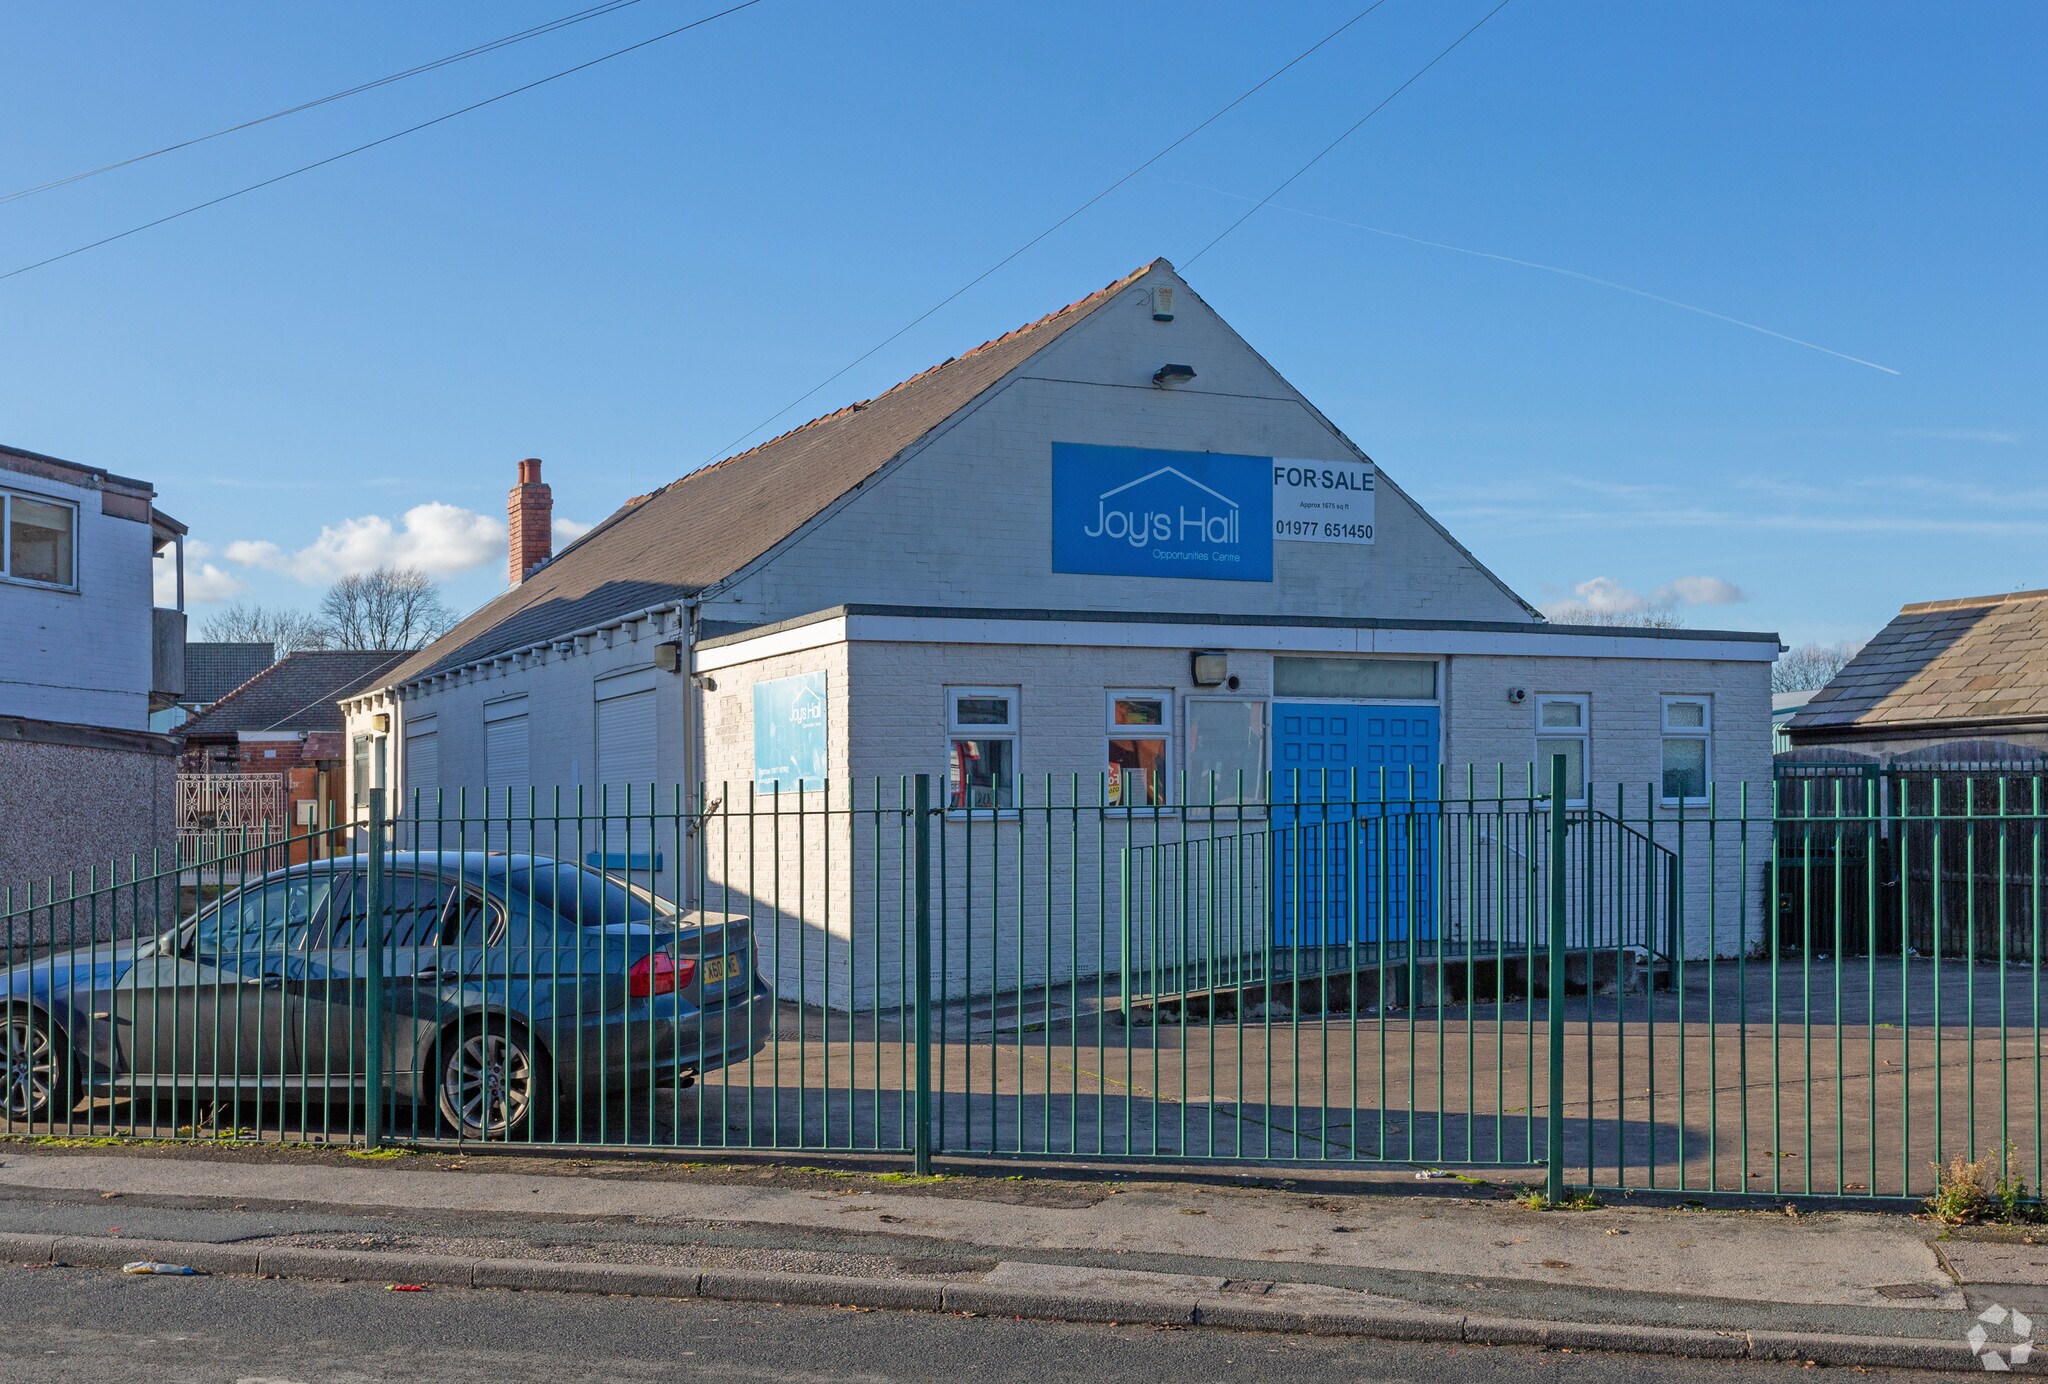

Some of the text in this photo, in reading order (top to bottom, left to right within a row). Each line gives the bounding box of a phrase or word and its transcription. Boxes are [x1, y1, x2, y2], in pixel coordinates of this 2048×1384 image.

[1274, 467, 1374, 491] FOR SALE
[1300, 502, 1320, 510] Approx
[1084, 501, 1239, 548] Joy's Hall
[1276, 519, 1373, 539] 01977 651450
[1153, 548, 1240, 562] Opportunities Centre
[807, 702, 822, 719] Hall
